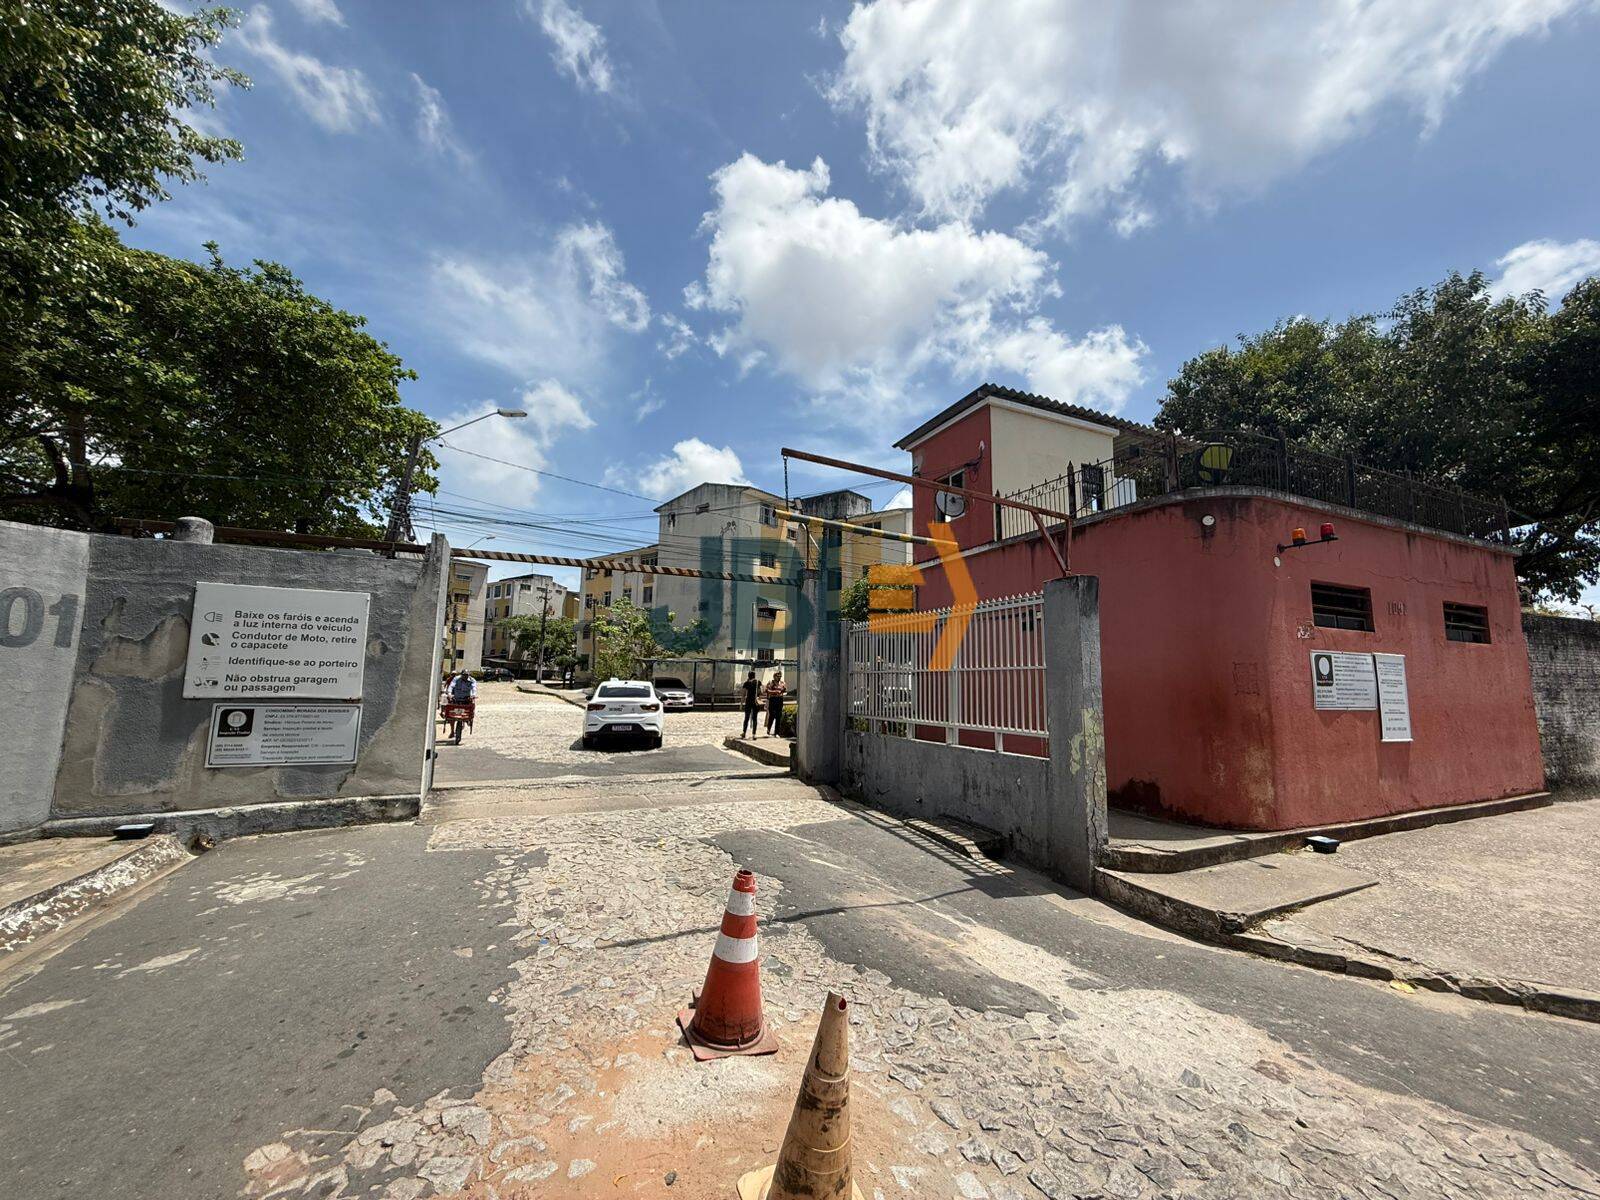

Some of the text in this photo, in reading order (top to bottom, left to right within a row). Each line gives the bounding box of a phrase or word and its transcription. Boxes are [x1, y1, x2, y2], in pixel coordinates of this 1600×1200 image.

[234, 610, 265, 620] Baixe
[267, 613, 280, 621] os
[283, 613, 312, 622] faróis
[323, 616, 359, 624] acenda
[243, 620, 259, 628] luz
[261, 621, 298, 630] interna
[300, 622, 314, 630] do
[232, 631, 282, 641] Condutor
[331, 635, 357, 644] retire
[240, 642, 289, 650] capacete
[228, 656, 301, 667] Identifique-se
[319, 660, 358, 668] porteiro
[225, 673, 338, 685] Não obstrua garagem
[241, 684, 296, 693] passagem
